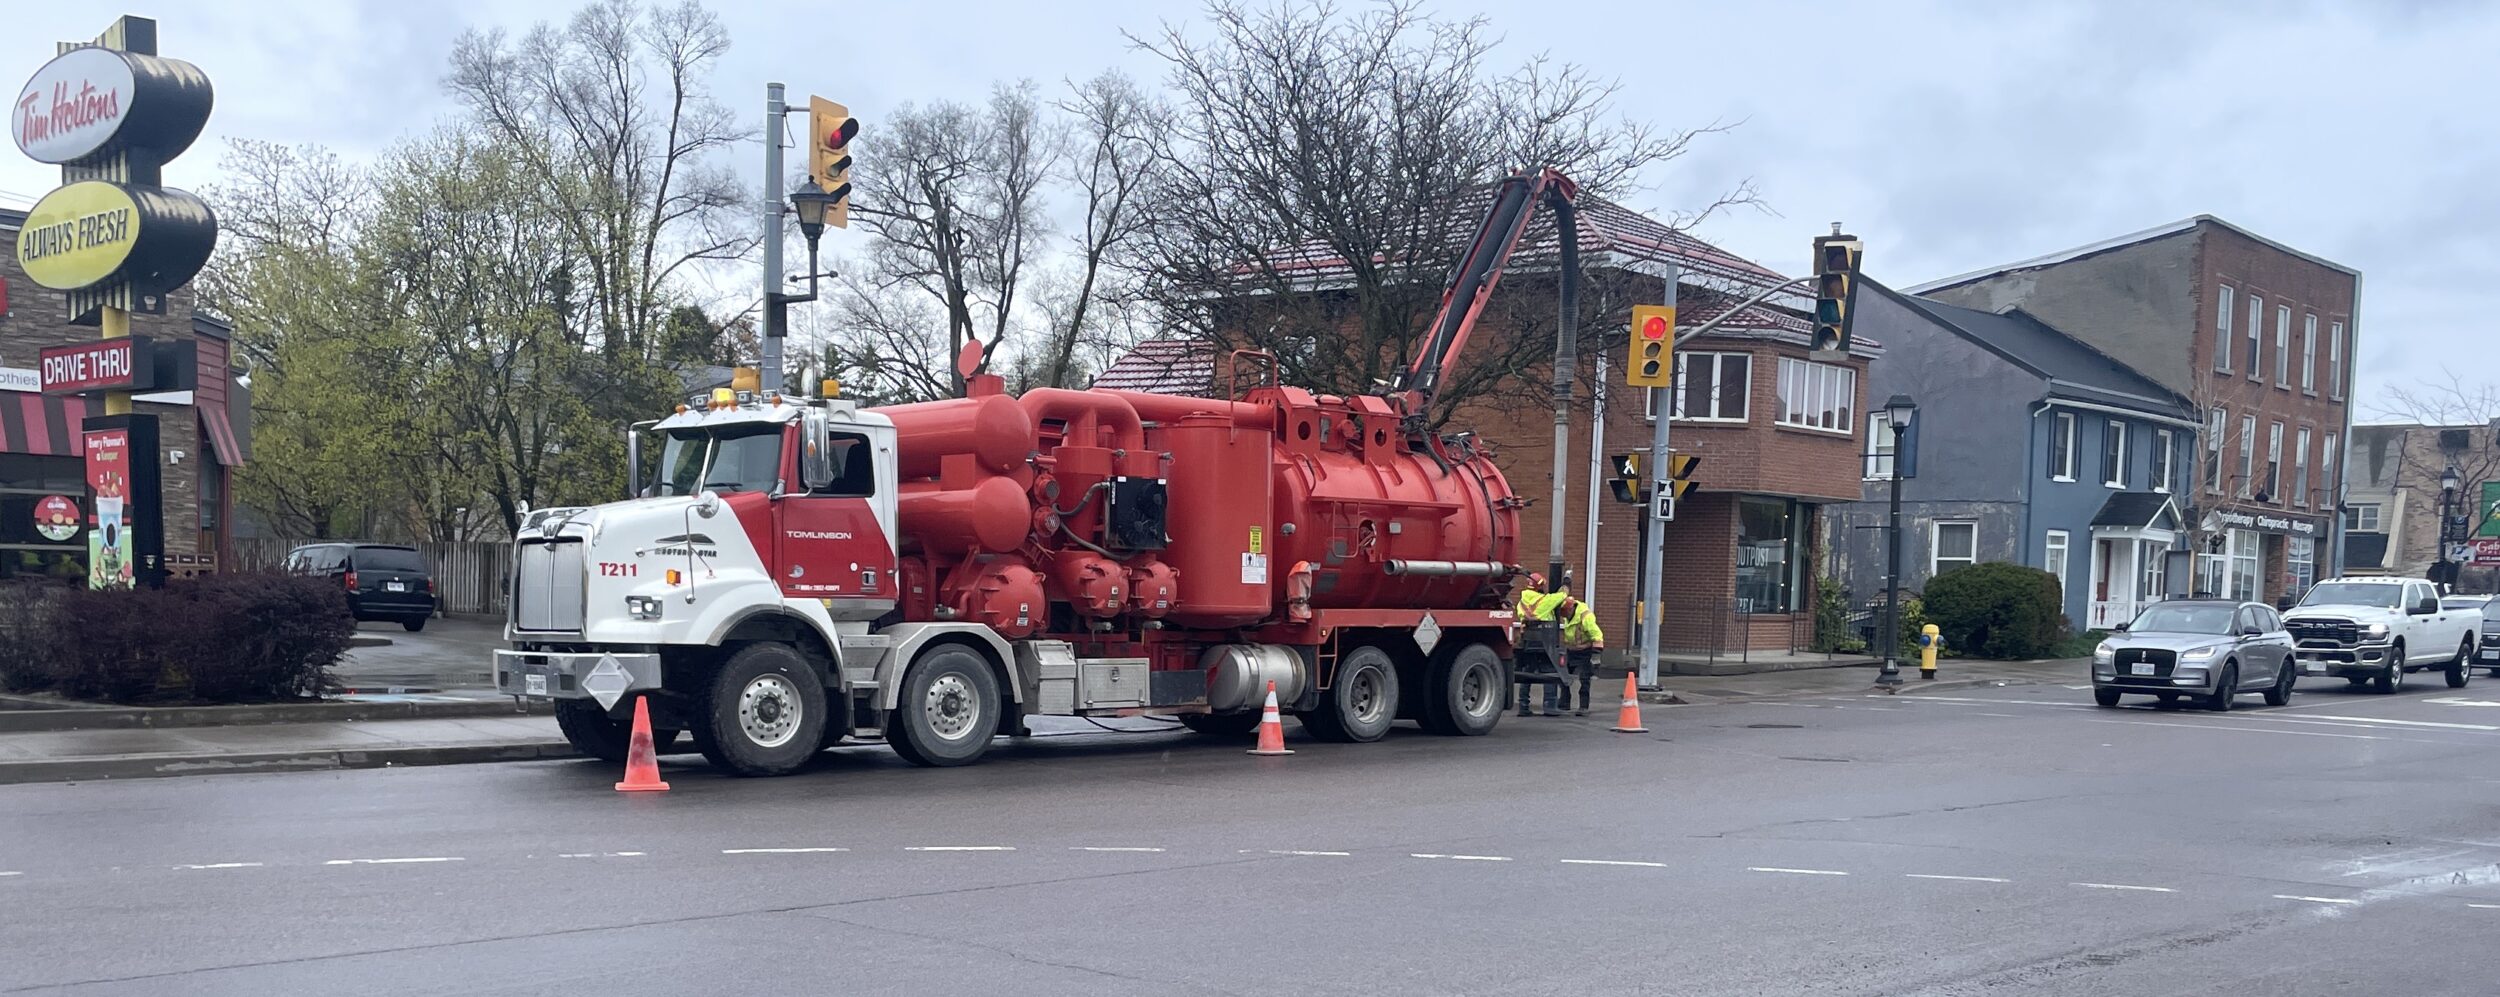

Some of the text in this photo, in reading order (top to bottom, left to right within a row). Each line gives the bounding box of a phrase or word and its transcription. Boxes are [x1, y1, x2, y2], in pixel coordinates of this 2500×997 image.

[20, 78, 118, 148] Tim Hortons
[23, 208, 129, 262] ALWAYS FRESH
[44, 347, 131, 385] DRIVE THRU
[786, 530, 852, 540] TOMLINSON
[599, 562, 638, 577] T211
